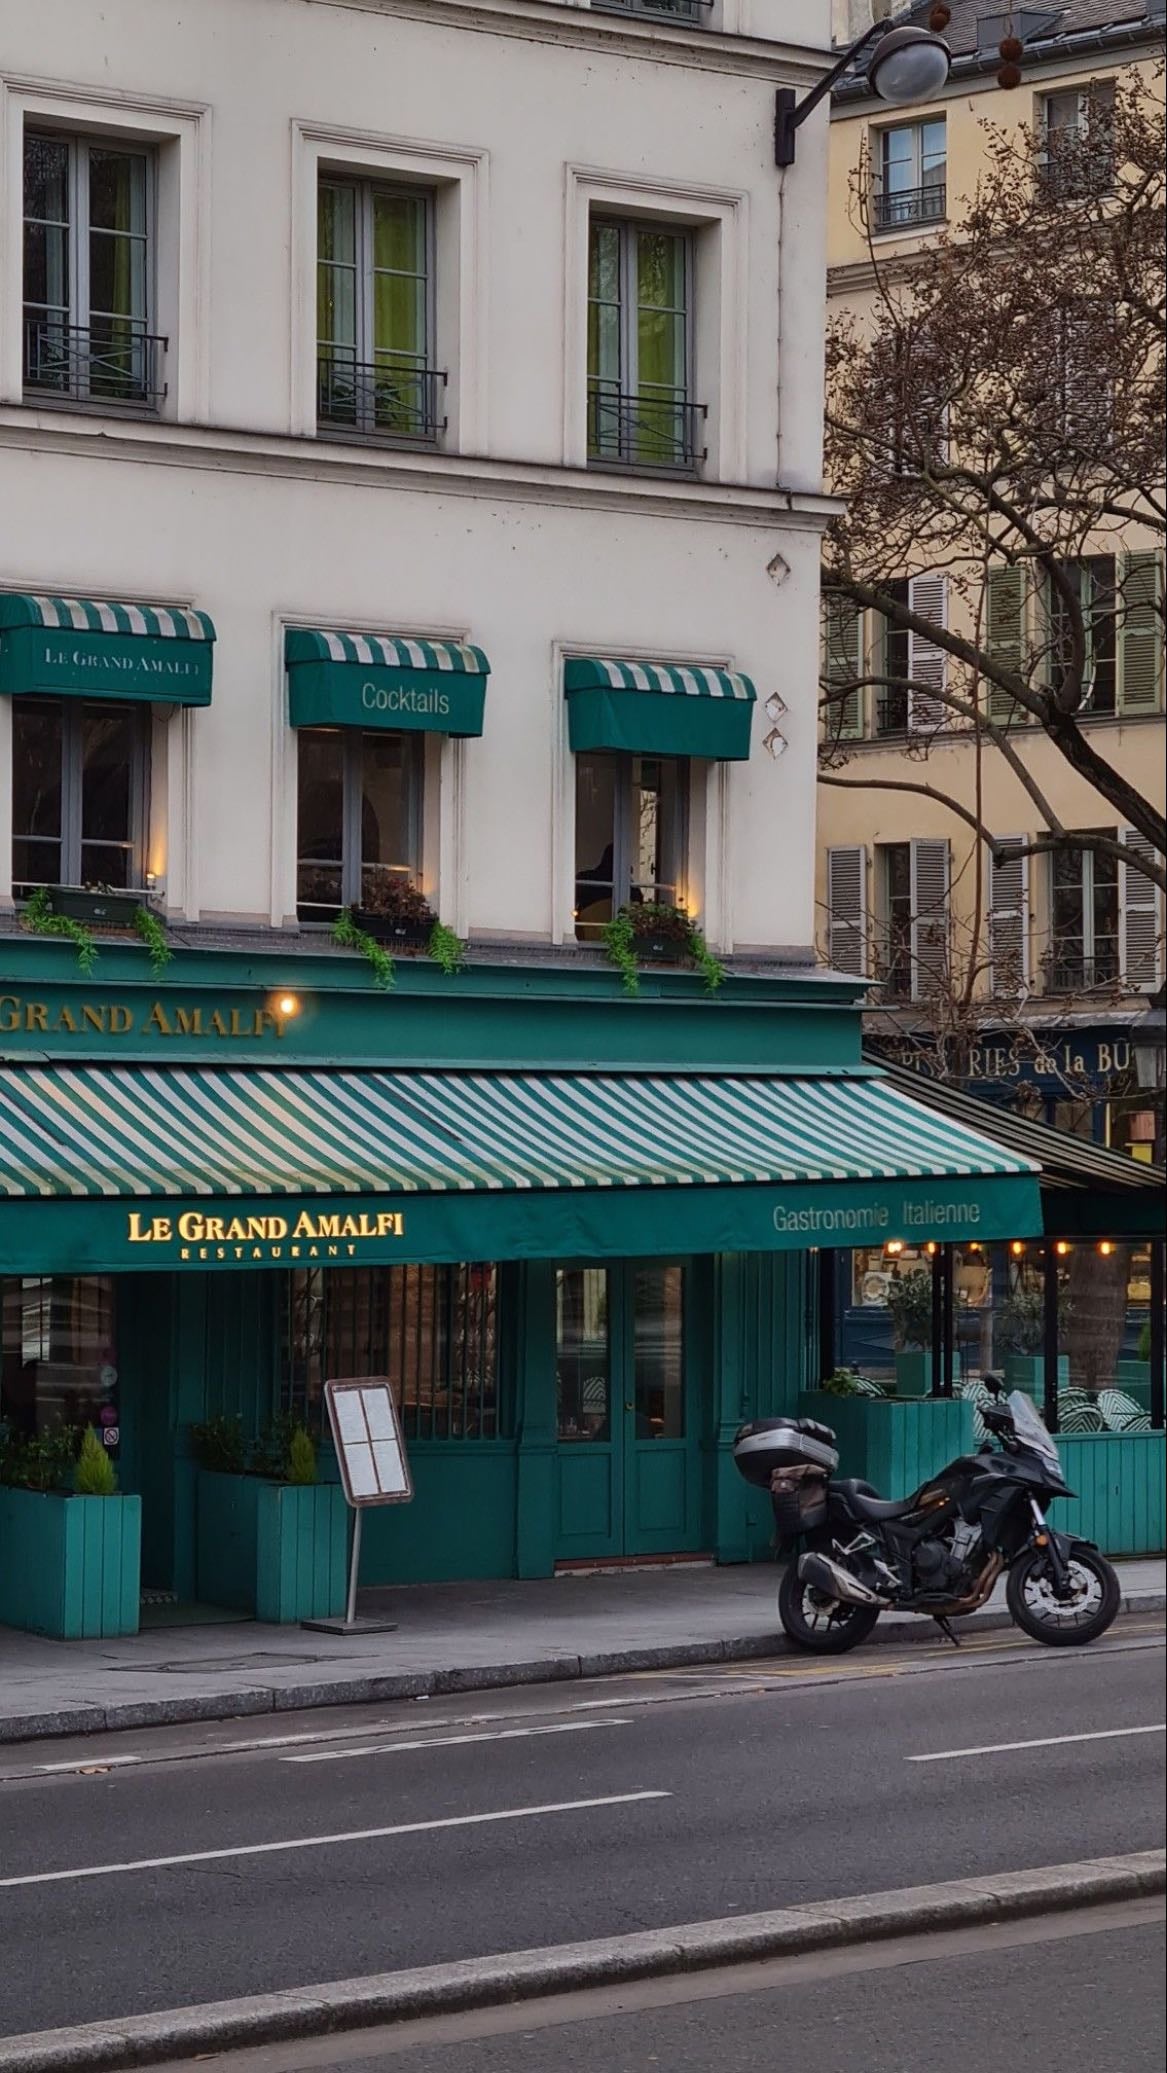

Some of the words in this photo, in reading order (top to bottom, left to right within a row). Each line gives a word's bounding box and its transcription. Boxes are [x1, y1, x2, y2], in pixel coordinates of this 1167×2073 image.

[44, 647, 68, 664] LE
[72, 650, 133, 670] GRAND
[362, 682, 450, 715] Cocktails
[0, 995, 133, 1032] GRAND
[1064, 1045, 1085, 1073] la
[128, 1213, 172, 1241] LE
[178, 1212, 288, 1240] GRAND
[292, 1210, 404, 1238] AMALFI
[773, 1202, 889, 1231] Gastronomie
[903, 1200, 980, 1225] Italienne
[181, 1244, 356, 1259] RESTAURANT
